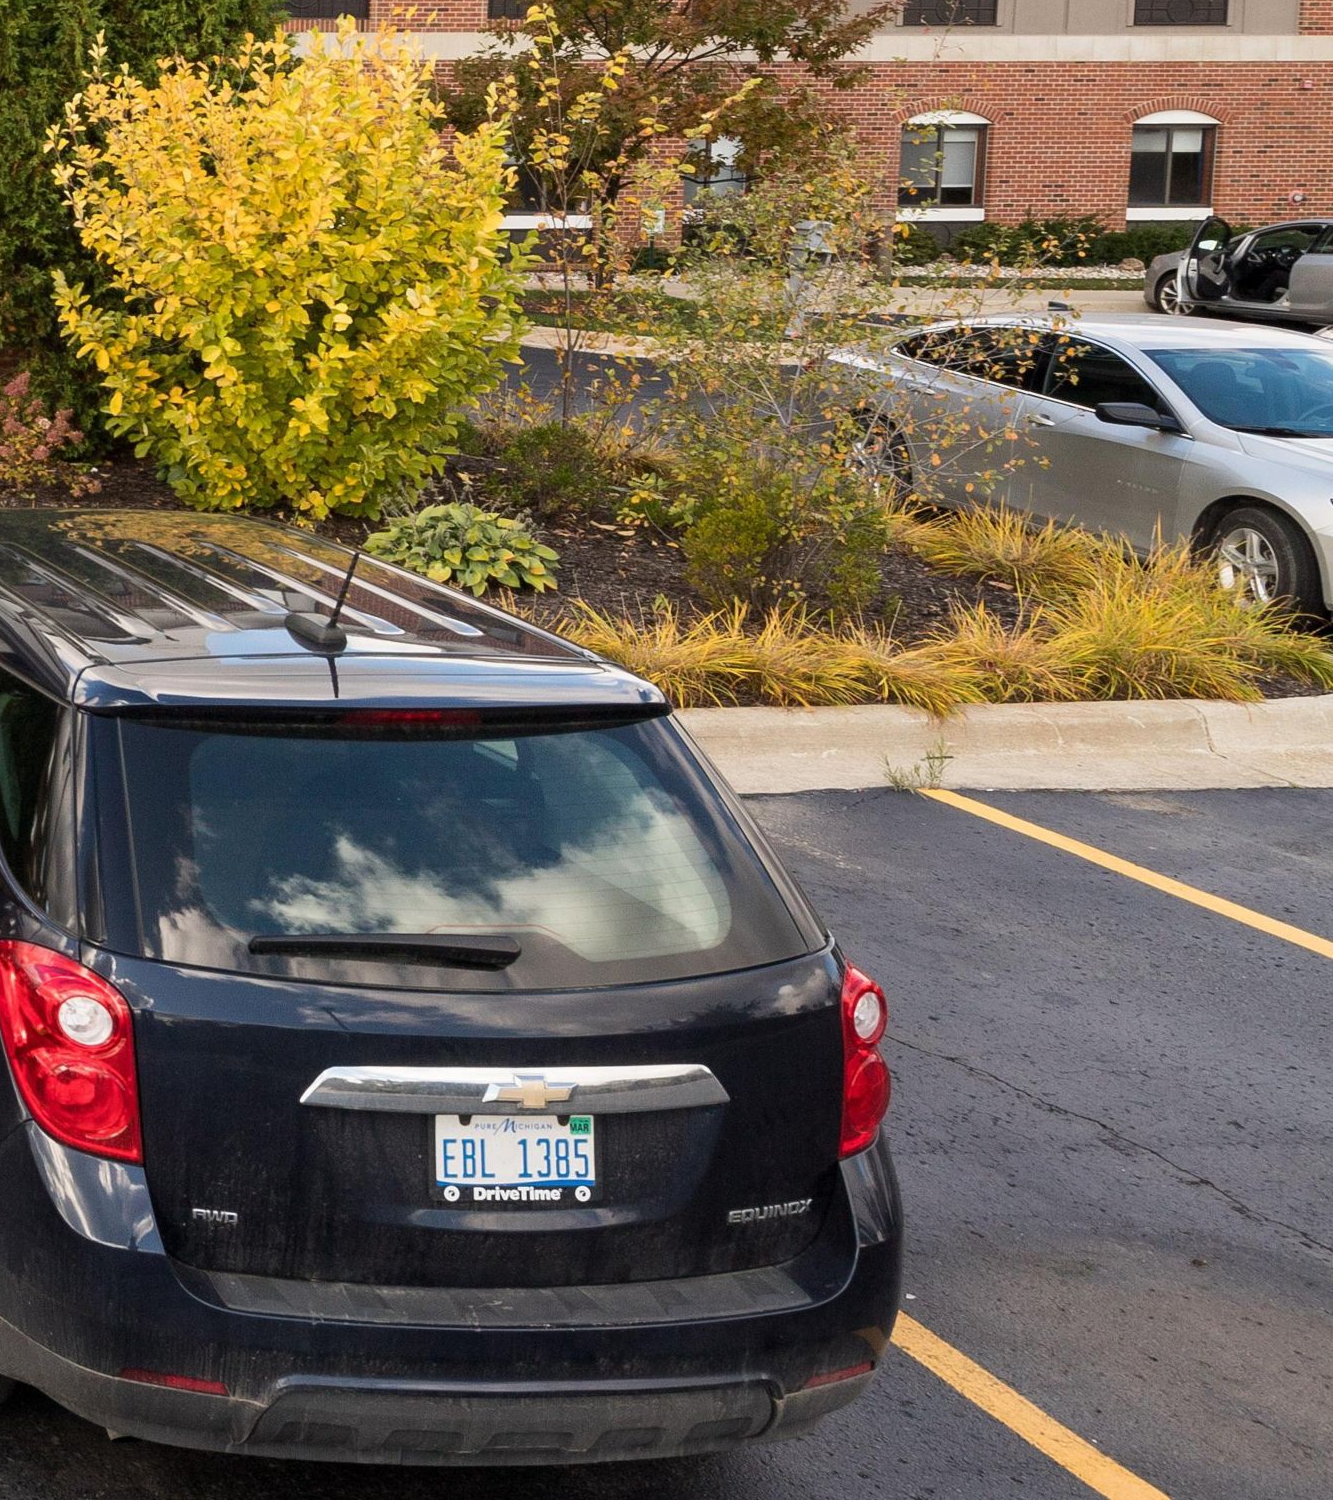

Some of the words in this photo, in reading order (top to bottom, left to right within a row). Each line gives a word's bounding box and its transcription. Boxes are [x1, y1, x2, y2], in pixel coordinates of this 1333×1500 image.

[570, 1123, 589, 1132] MAR
[443, 1138, 495, 1178] EBL
[517, 1138, 589, 1179] 1385
[473, 1187, 562, 1201] DriveTime
[192, 1208, 238, 1223] AWD
[728, 1198, 813, 1224] EQUINOX
